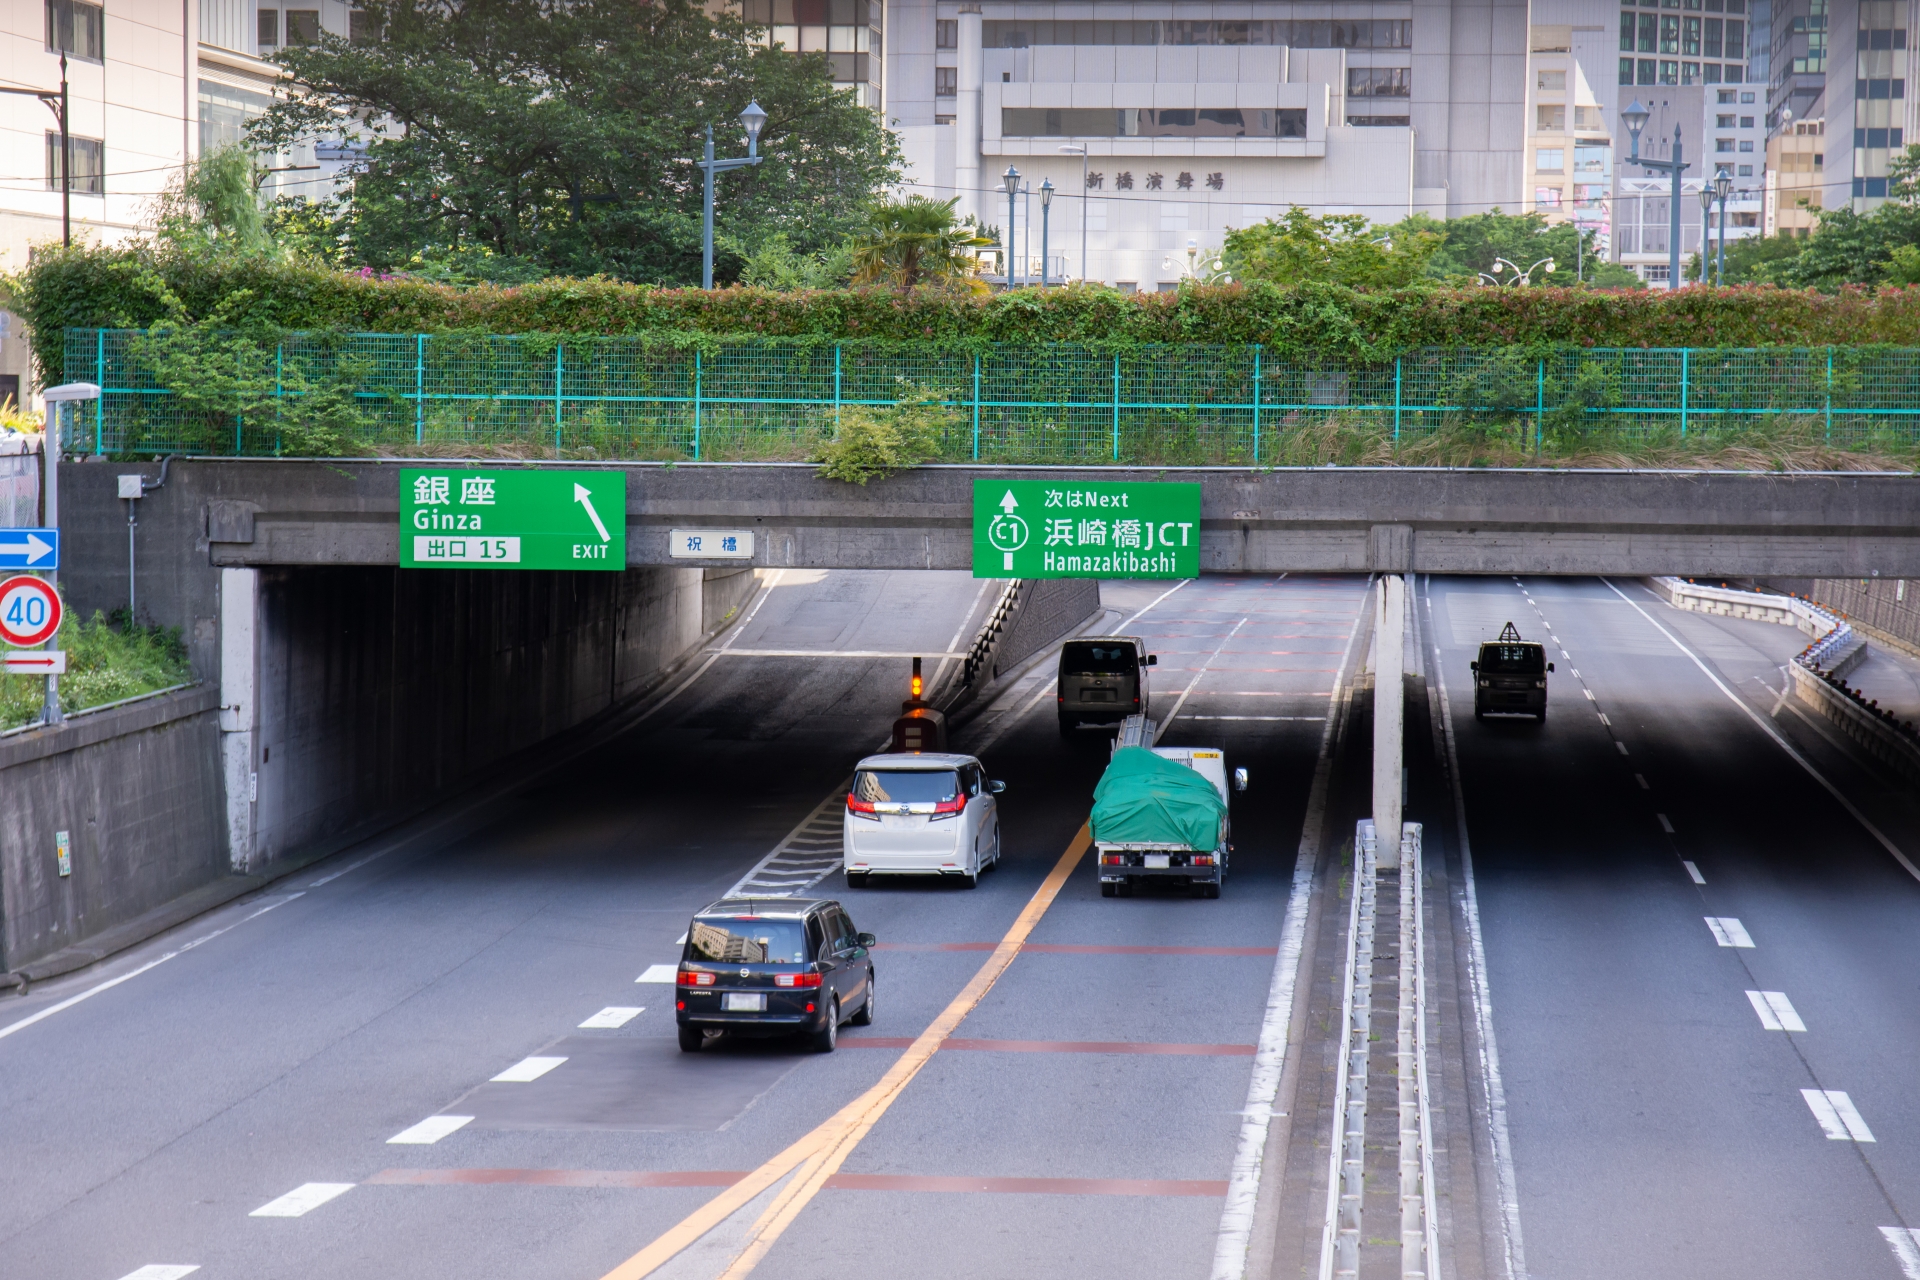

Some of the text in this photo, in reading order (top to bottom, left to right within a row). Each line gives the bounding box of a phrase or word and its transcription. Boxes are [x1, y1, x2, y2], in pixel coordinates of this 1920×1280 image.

[1087, 171, 1225, 190] 新橋演舞場
[414, 476, 496, 505] 銀座
[414, 510, 482, 530] Ginza
[996, 522, 1018, 544] C1
[1043, 518, 1193, 550] 浜崎橋JCT
[428, 540, 507, 558] 出口 15
[572, 544, 608, 559] EXIT
[686, 536, 737, 552] 祝橋
[1044, 552, 1176, 572] Hamazakibashi
[7, 596, 45, 626] 40
